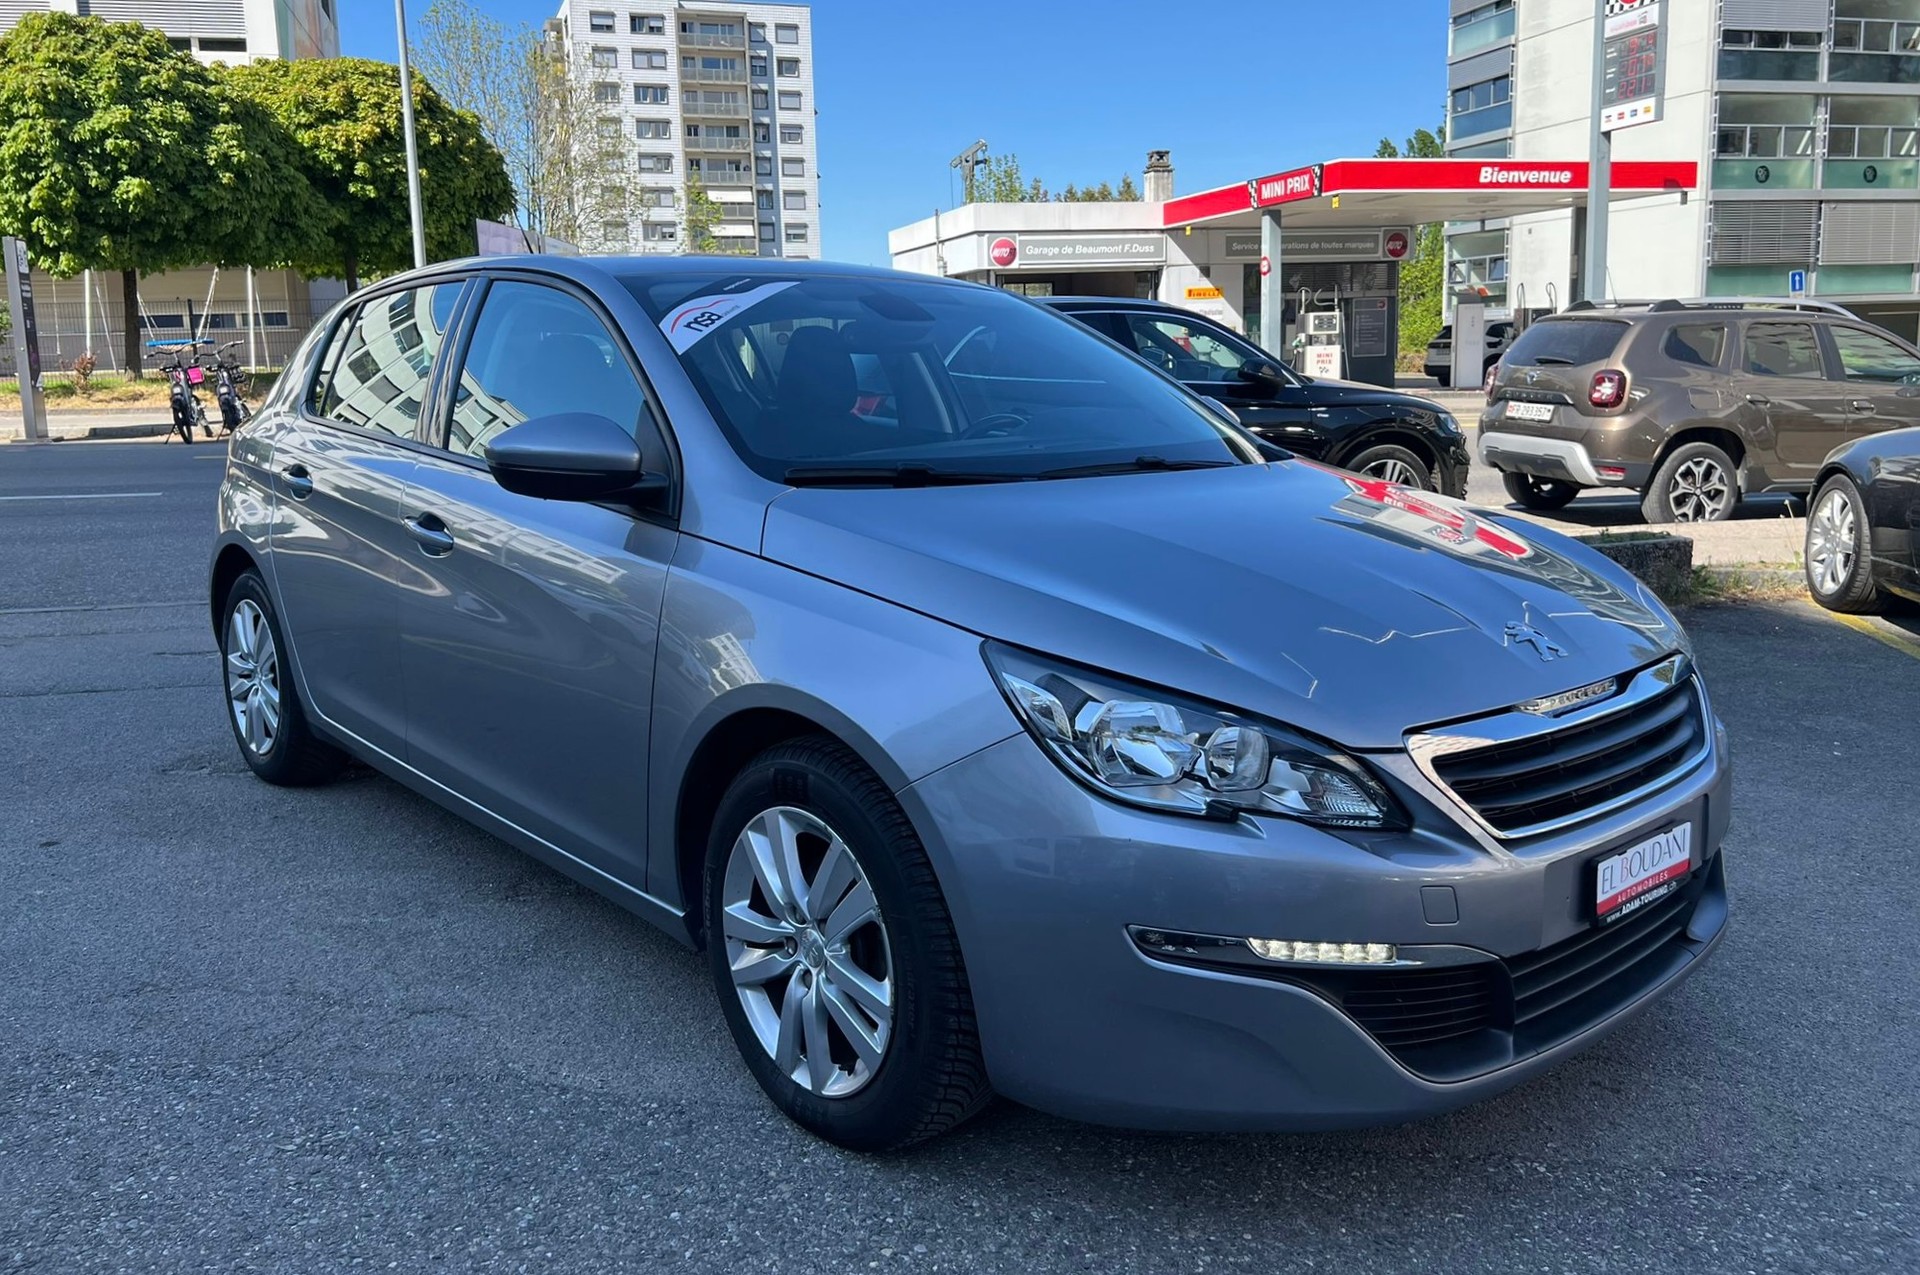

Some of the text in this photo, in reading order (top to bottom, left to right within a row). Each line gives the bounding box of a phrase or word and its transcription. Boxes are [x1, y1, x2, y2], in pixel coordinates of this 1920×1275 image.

[1479, 166, 1572, 184] Bienvenue
[1261, 173, 1310, 200] MINI PRIX
[1025, 243, 1155, 256] Garage de Beaumont F.Duss
[1232, 242, 1259, 251] Service
[1310, 242, 1320, 250] de
[683, 311, 723, 332] nsa
[1601, 828, 1686, 895] EL BOUDANI
[1616, 871, 1668, 904] AUTOMOBILES
